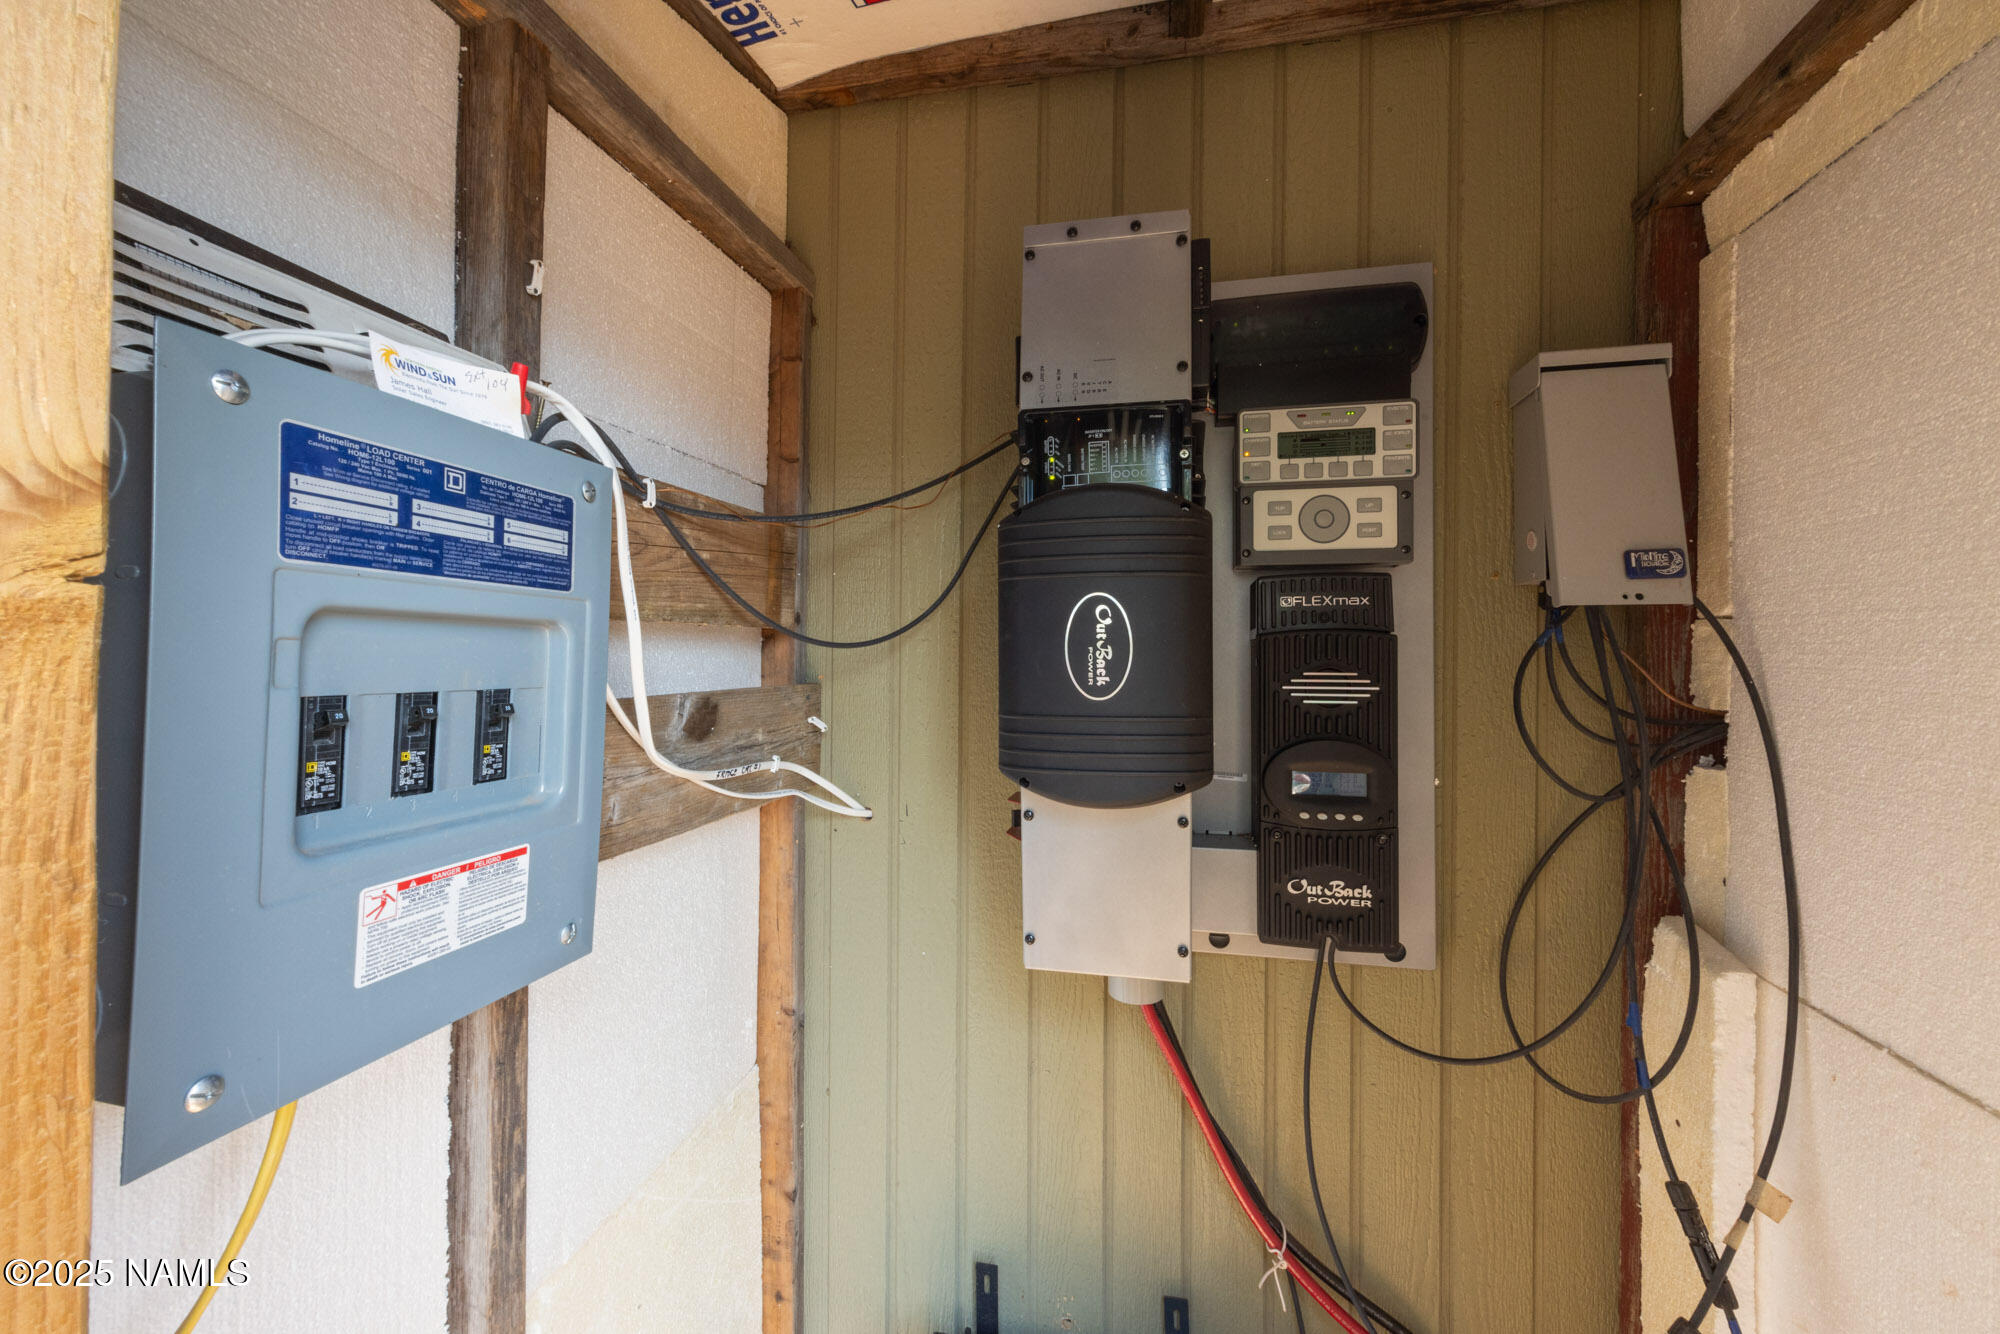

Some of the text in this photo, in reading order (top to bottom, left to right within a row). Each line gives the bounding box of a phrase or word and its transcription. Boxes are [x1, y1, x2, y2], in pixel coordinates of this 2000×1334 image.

[390, 376, 415, 390] James
[307, 440, 329, 450] Catalog
[367, 445, 391, 458] LOAD
[392, 452, 425, 467] CENTER
[480, 476, 507, 489] CENTRO
[516, 486, 537, 497] CARGA
[1293, 595, 1370, 607] FLEXmax
[431, 866, 461, 881] DANGER
[474, 856, 502, 870] PELIGRO
[1307, 896, 1373, 908] POWER
